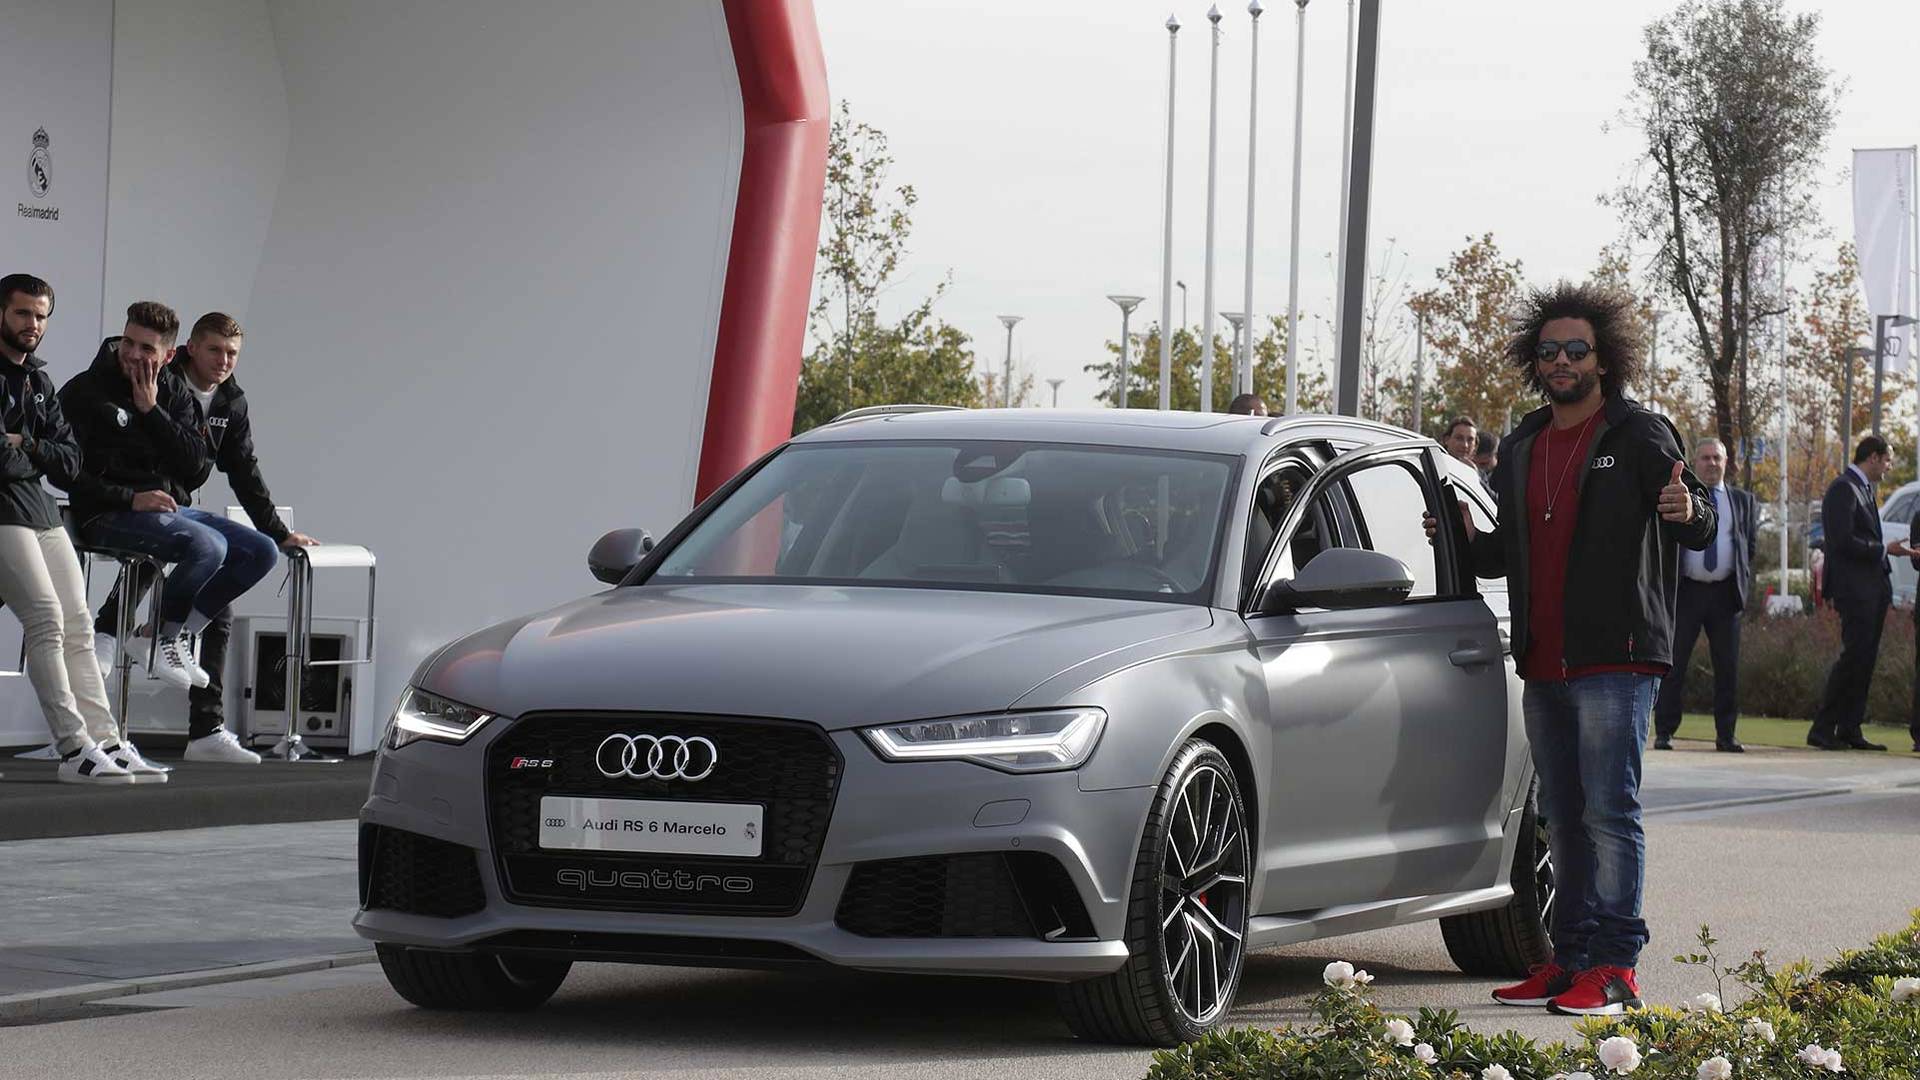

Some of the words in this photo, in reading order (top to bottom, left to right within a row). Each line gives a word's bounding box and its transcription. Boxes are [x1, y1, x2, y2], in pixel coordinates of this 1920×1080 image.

[582, 818, 619, 831] Audi
[623, 820, 644, 832] RS
[648, 821, 658, 833] 6
[663, 822, 727, 836] Marcelo
[556, 868, 754, 893] quattro
